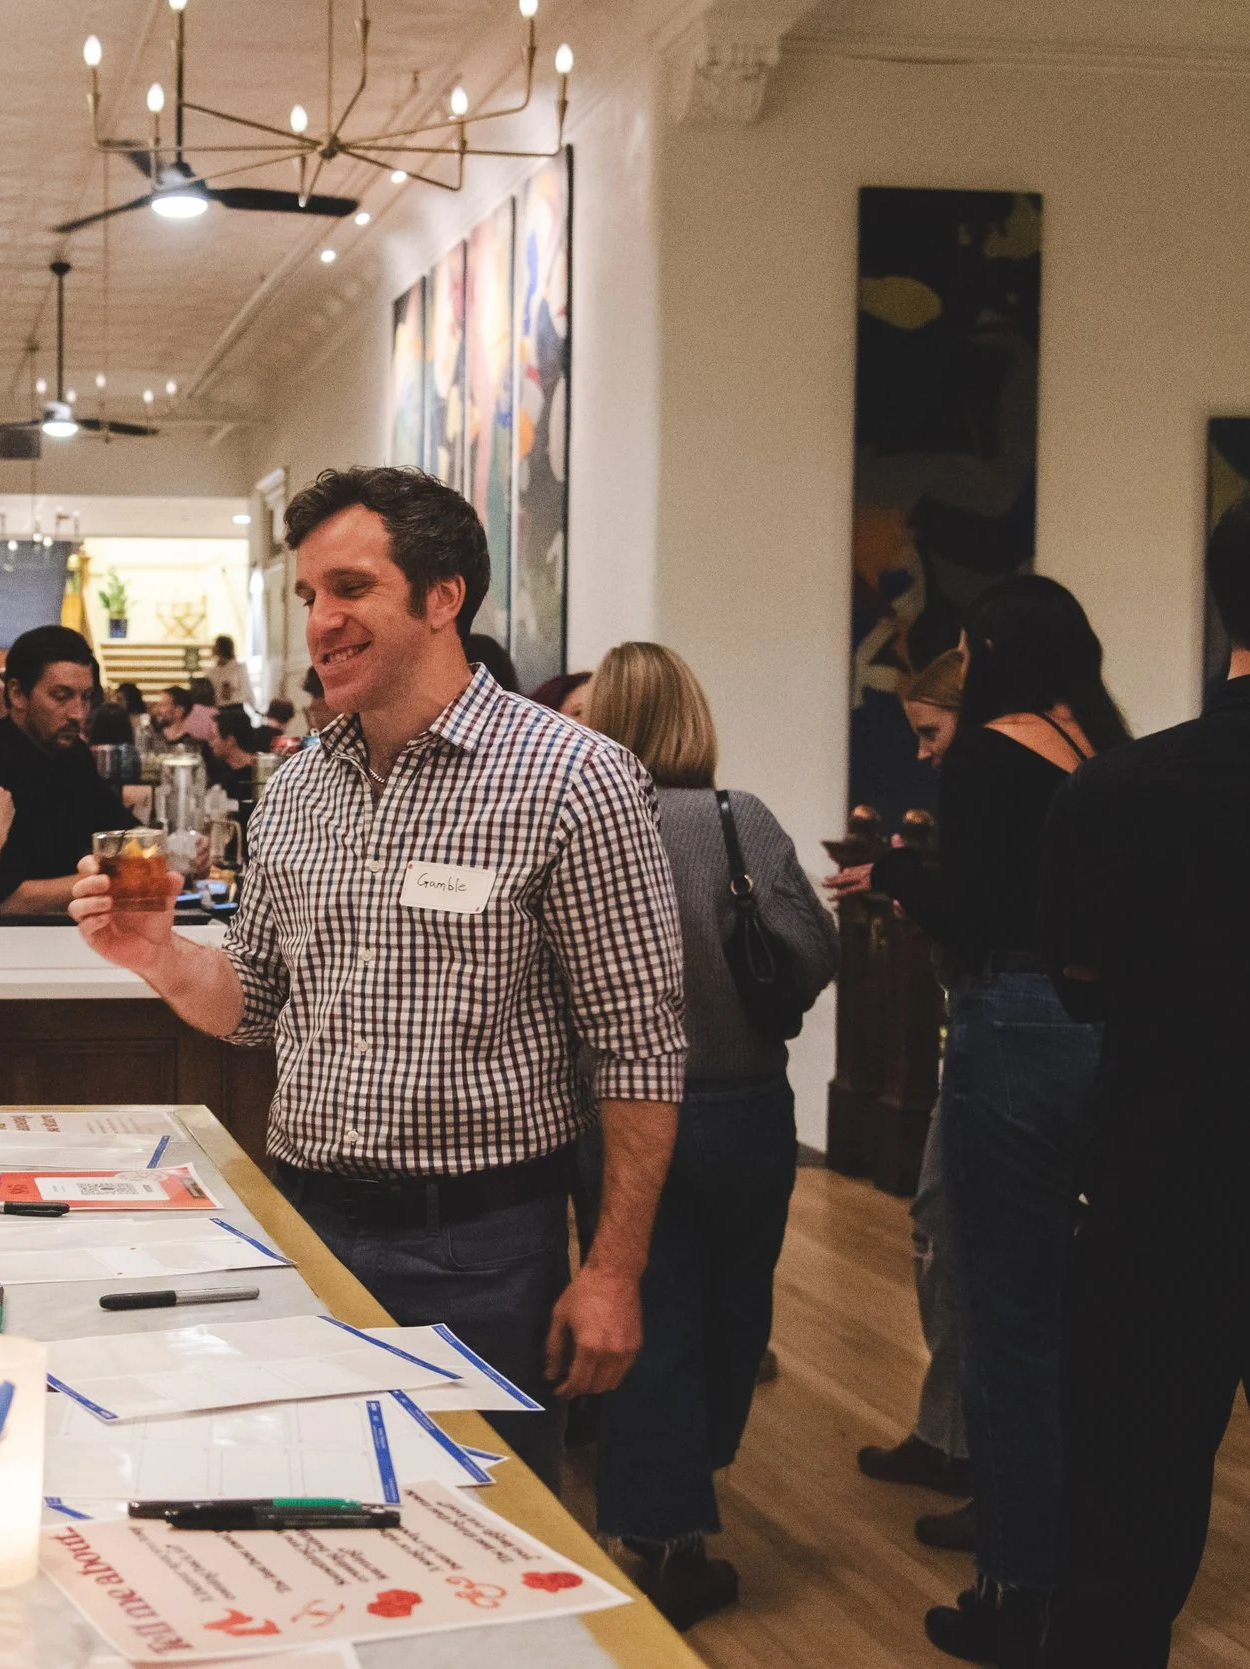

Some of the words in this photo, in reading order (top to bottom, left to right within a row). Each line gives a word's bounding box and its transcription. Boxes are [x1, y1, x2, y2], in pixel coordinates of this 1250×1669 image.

[417, 872, 467, 892] Gamble
[105, 1587, 159, 1619] me
[127, 1620, 194, 1654] Tell
